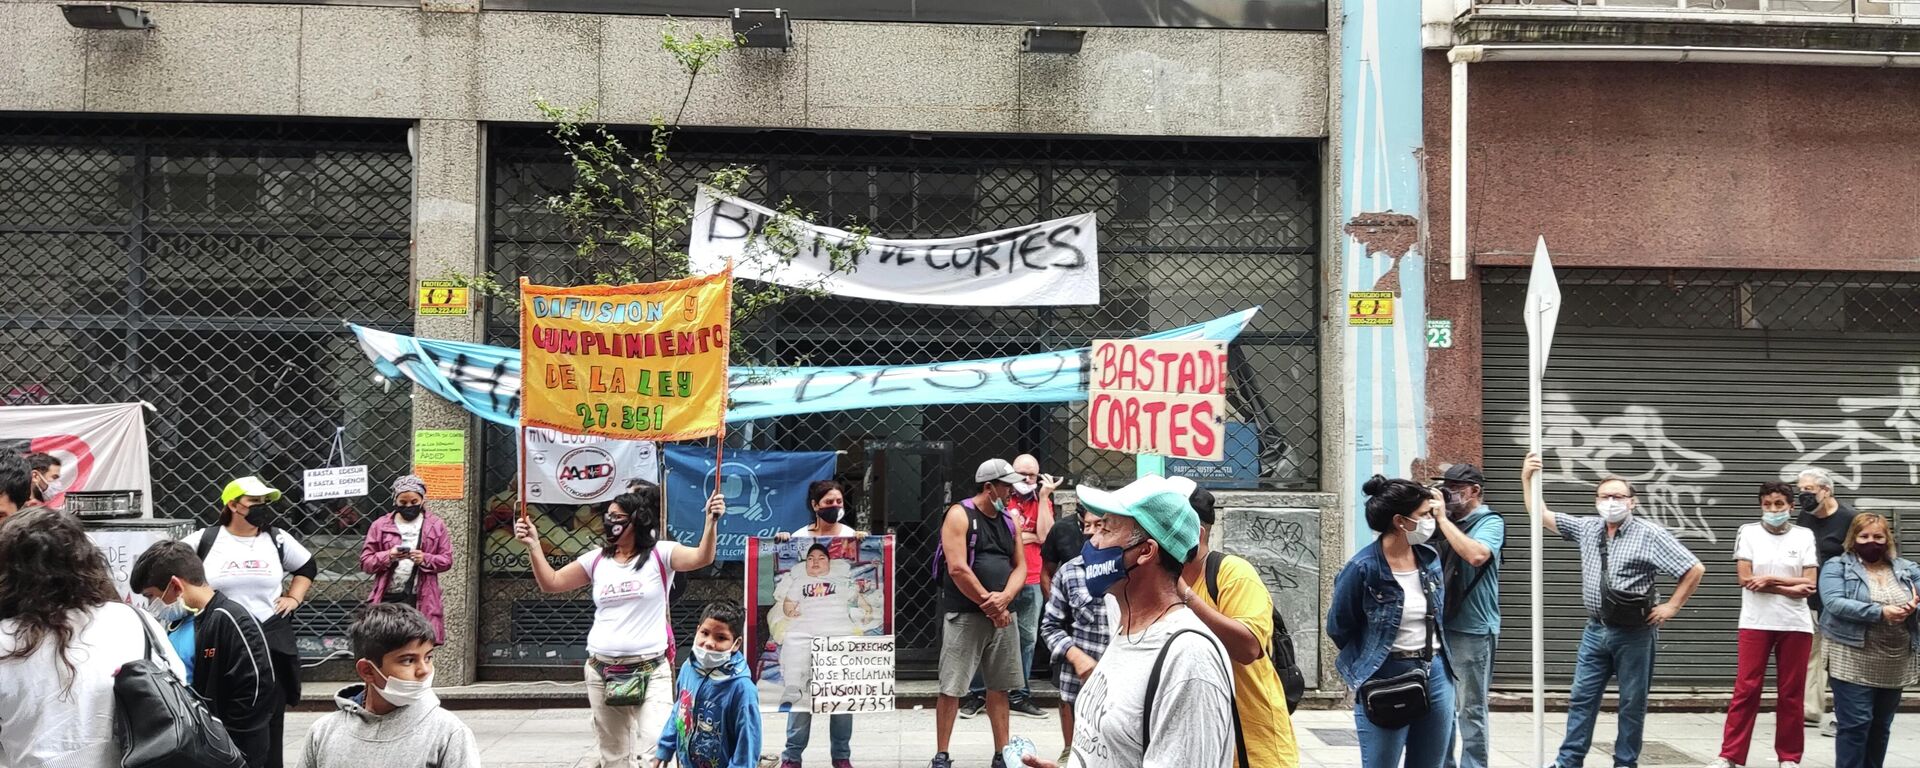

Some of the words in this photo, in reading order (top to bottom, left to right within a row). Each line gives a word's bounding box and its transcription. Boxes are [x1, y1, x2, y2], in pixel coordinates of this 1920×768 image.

[924, 224, 1086, 277] CORTES
[533, 296, 664, 324] DIFUSION
[684, 295, 698, 322] Y
[532, 324, 724, 358] CUMPLIMIENTO
[1428, 328, 1452, 348] 23
[546, 364, 577, 390] DE
[589, 366, 625, 393] LA
[637, 369, 693, 397] LEY
[576, 403, 664, 431] 27.351
[1090, 394, 1215, 457] CORTES
[109, 546, 128, 563] DE
[848, 641, 894, 652] DERECHOS
[866, 684, 877, 695] DE
[882, 682, 895, 696] LA
[812, 698, 841, 713] LEY
[847, 697, 894, 711] 27351
